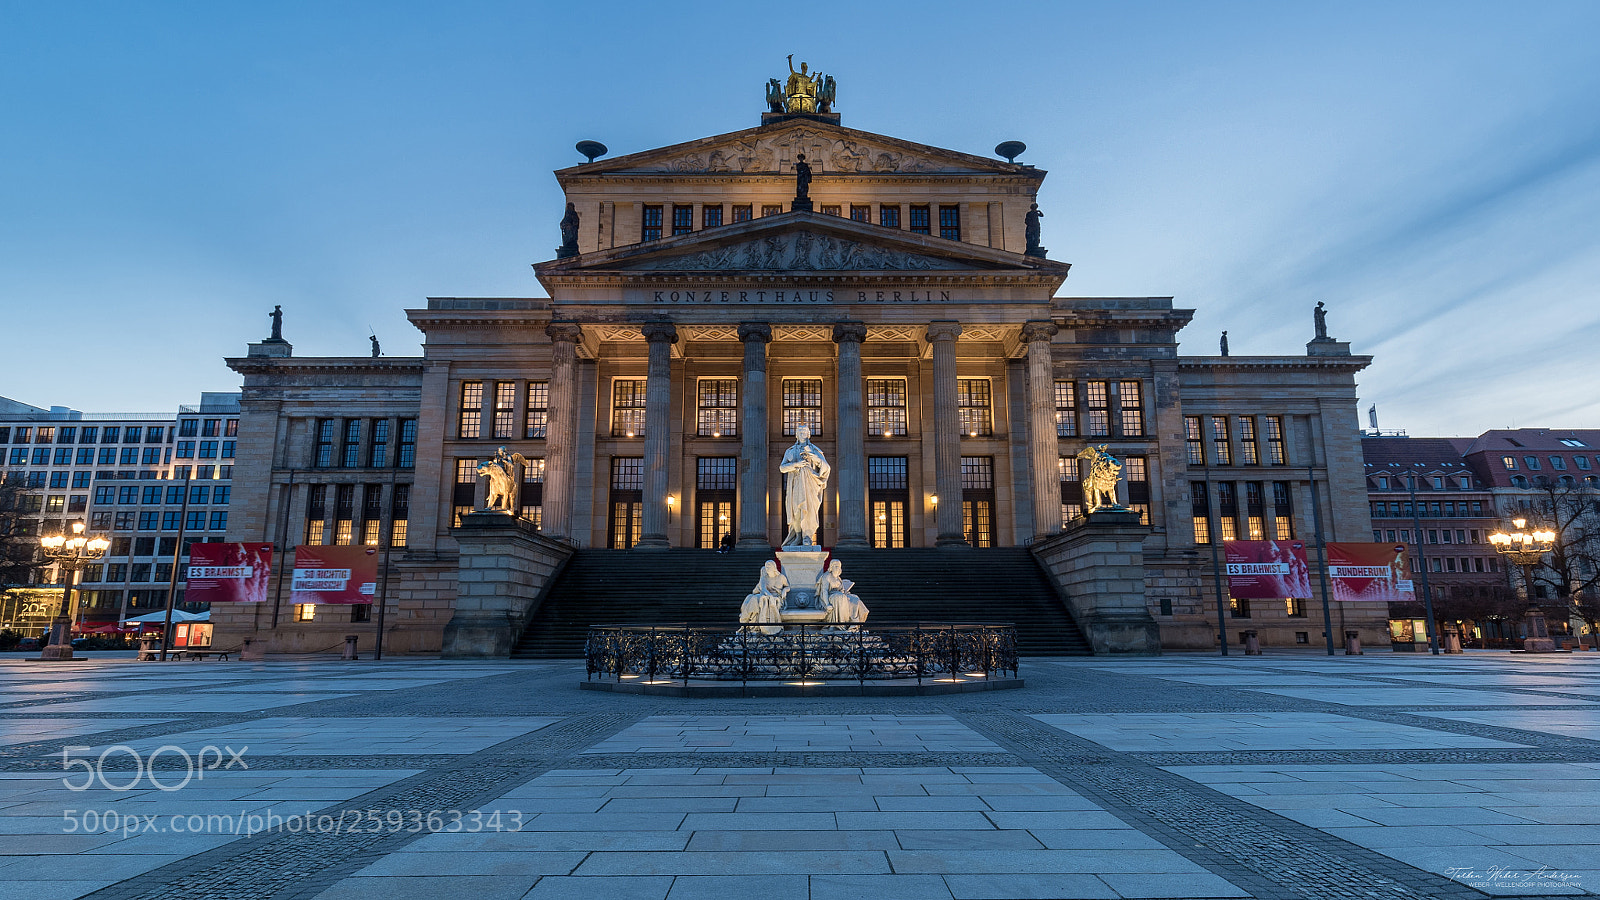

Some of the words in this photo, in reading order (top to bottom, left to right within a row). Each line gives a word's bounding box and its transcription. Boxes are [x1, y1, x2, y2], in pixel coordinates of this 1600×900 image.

[654, 291, 834, 303] KONZERTHAUS
[857, 291, 950, 303] BERLIN
[190, 567, 202, 577] ES
[1229, 565, 1240, 574] ES
